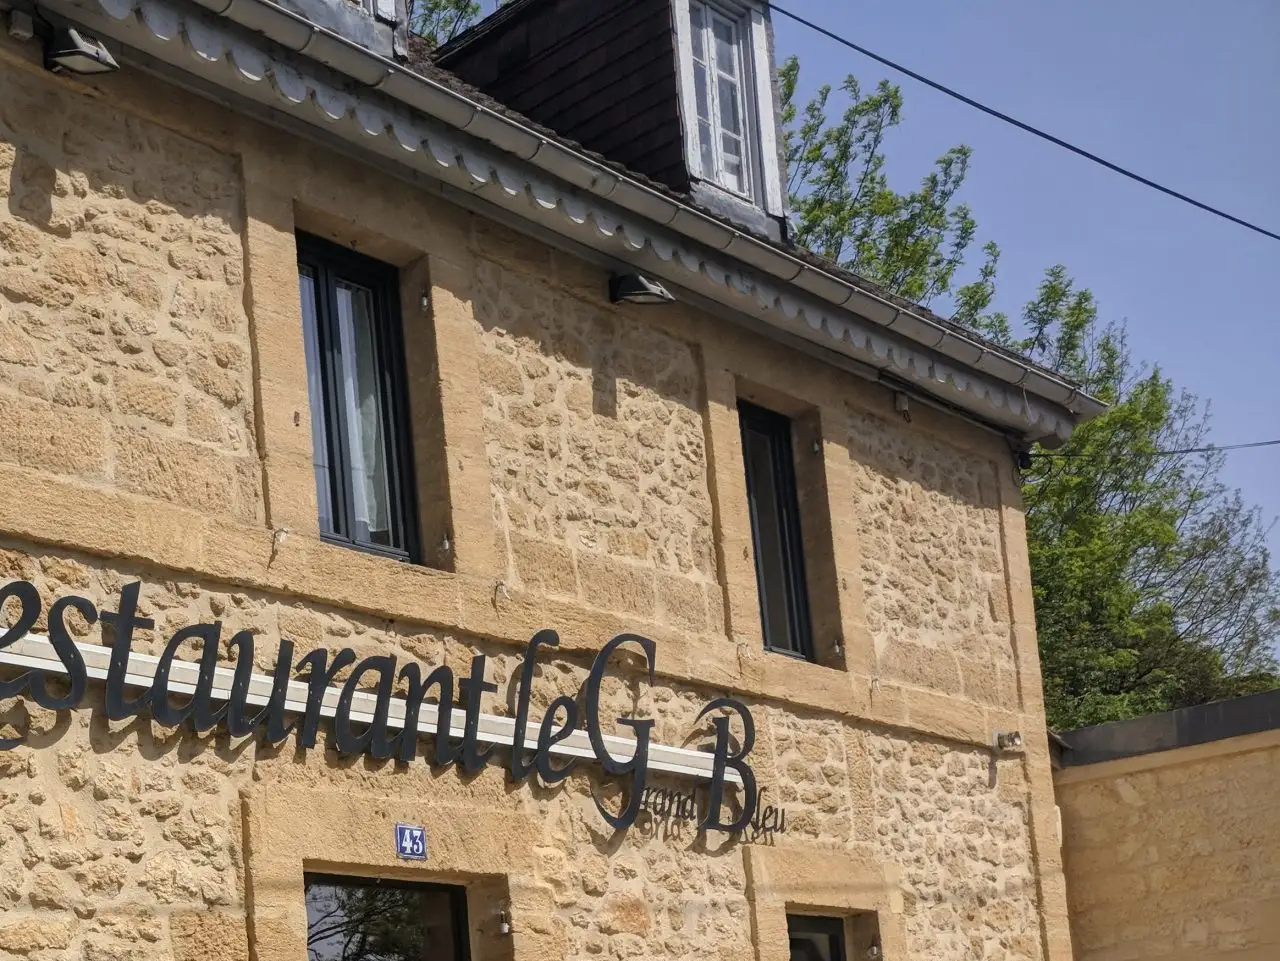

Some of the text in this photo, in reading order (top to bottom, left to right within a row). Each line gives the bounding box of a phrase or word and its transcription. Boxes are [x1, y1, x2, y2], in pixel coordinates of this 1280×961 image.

[511, 629, 580, 783] le
[587, 633, 696, 830] Grand
[694, 699, 786, 833] Bleu
[402, 829, 423, 854] 43
